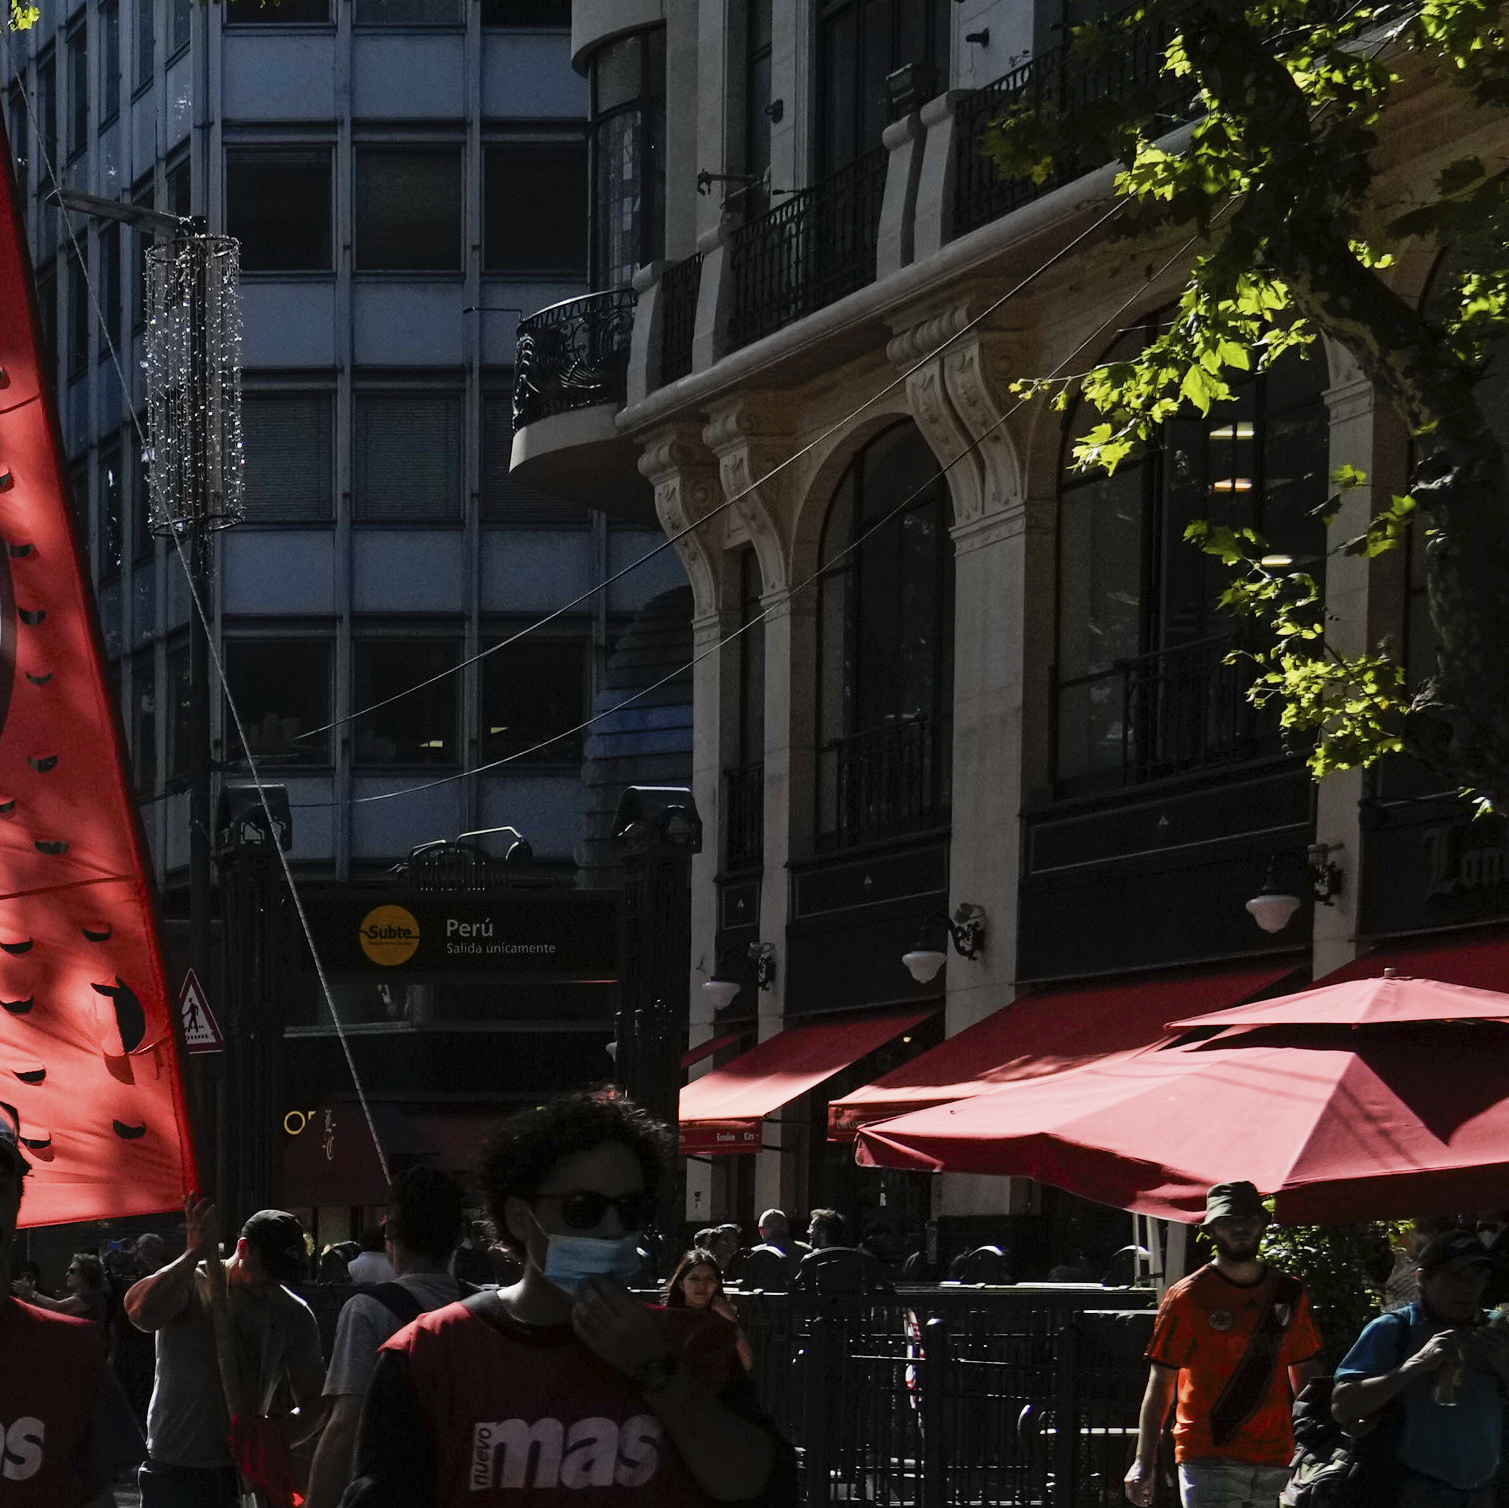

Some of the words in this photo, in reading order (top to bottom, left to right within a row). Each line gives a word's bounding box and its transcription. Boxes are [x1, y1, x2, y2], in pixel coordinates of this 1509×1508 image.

[368, 925, 412, 940] Subte
[446, 918, 494, 937] Perú
[446, 942, 482, 954] Salida
[486, 941, 557, 954] únicamente
[469, 1414, 664, 1491] mas
[474, 1427, 492, 1486] nuevo
